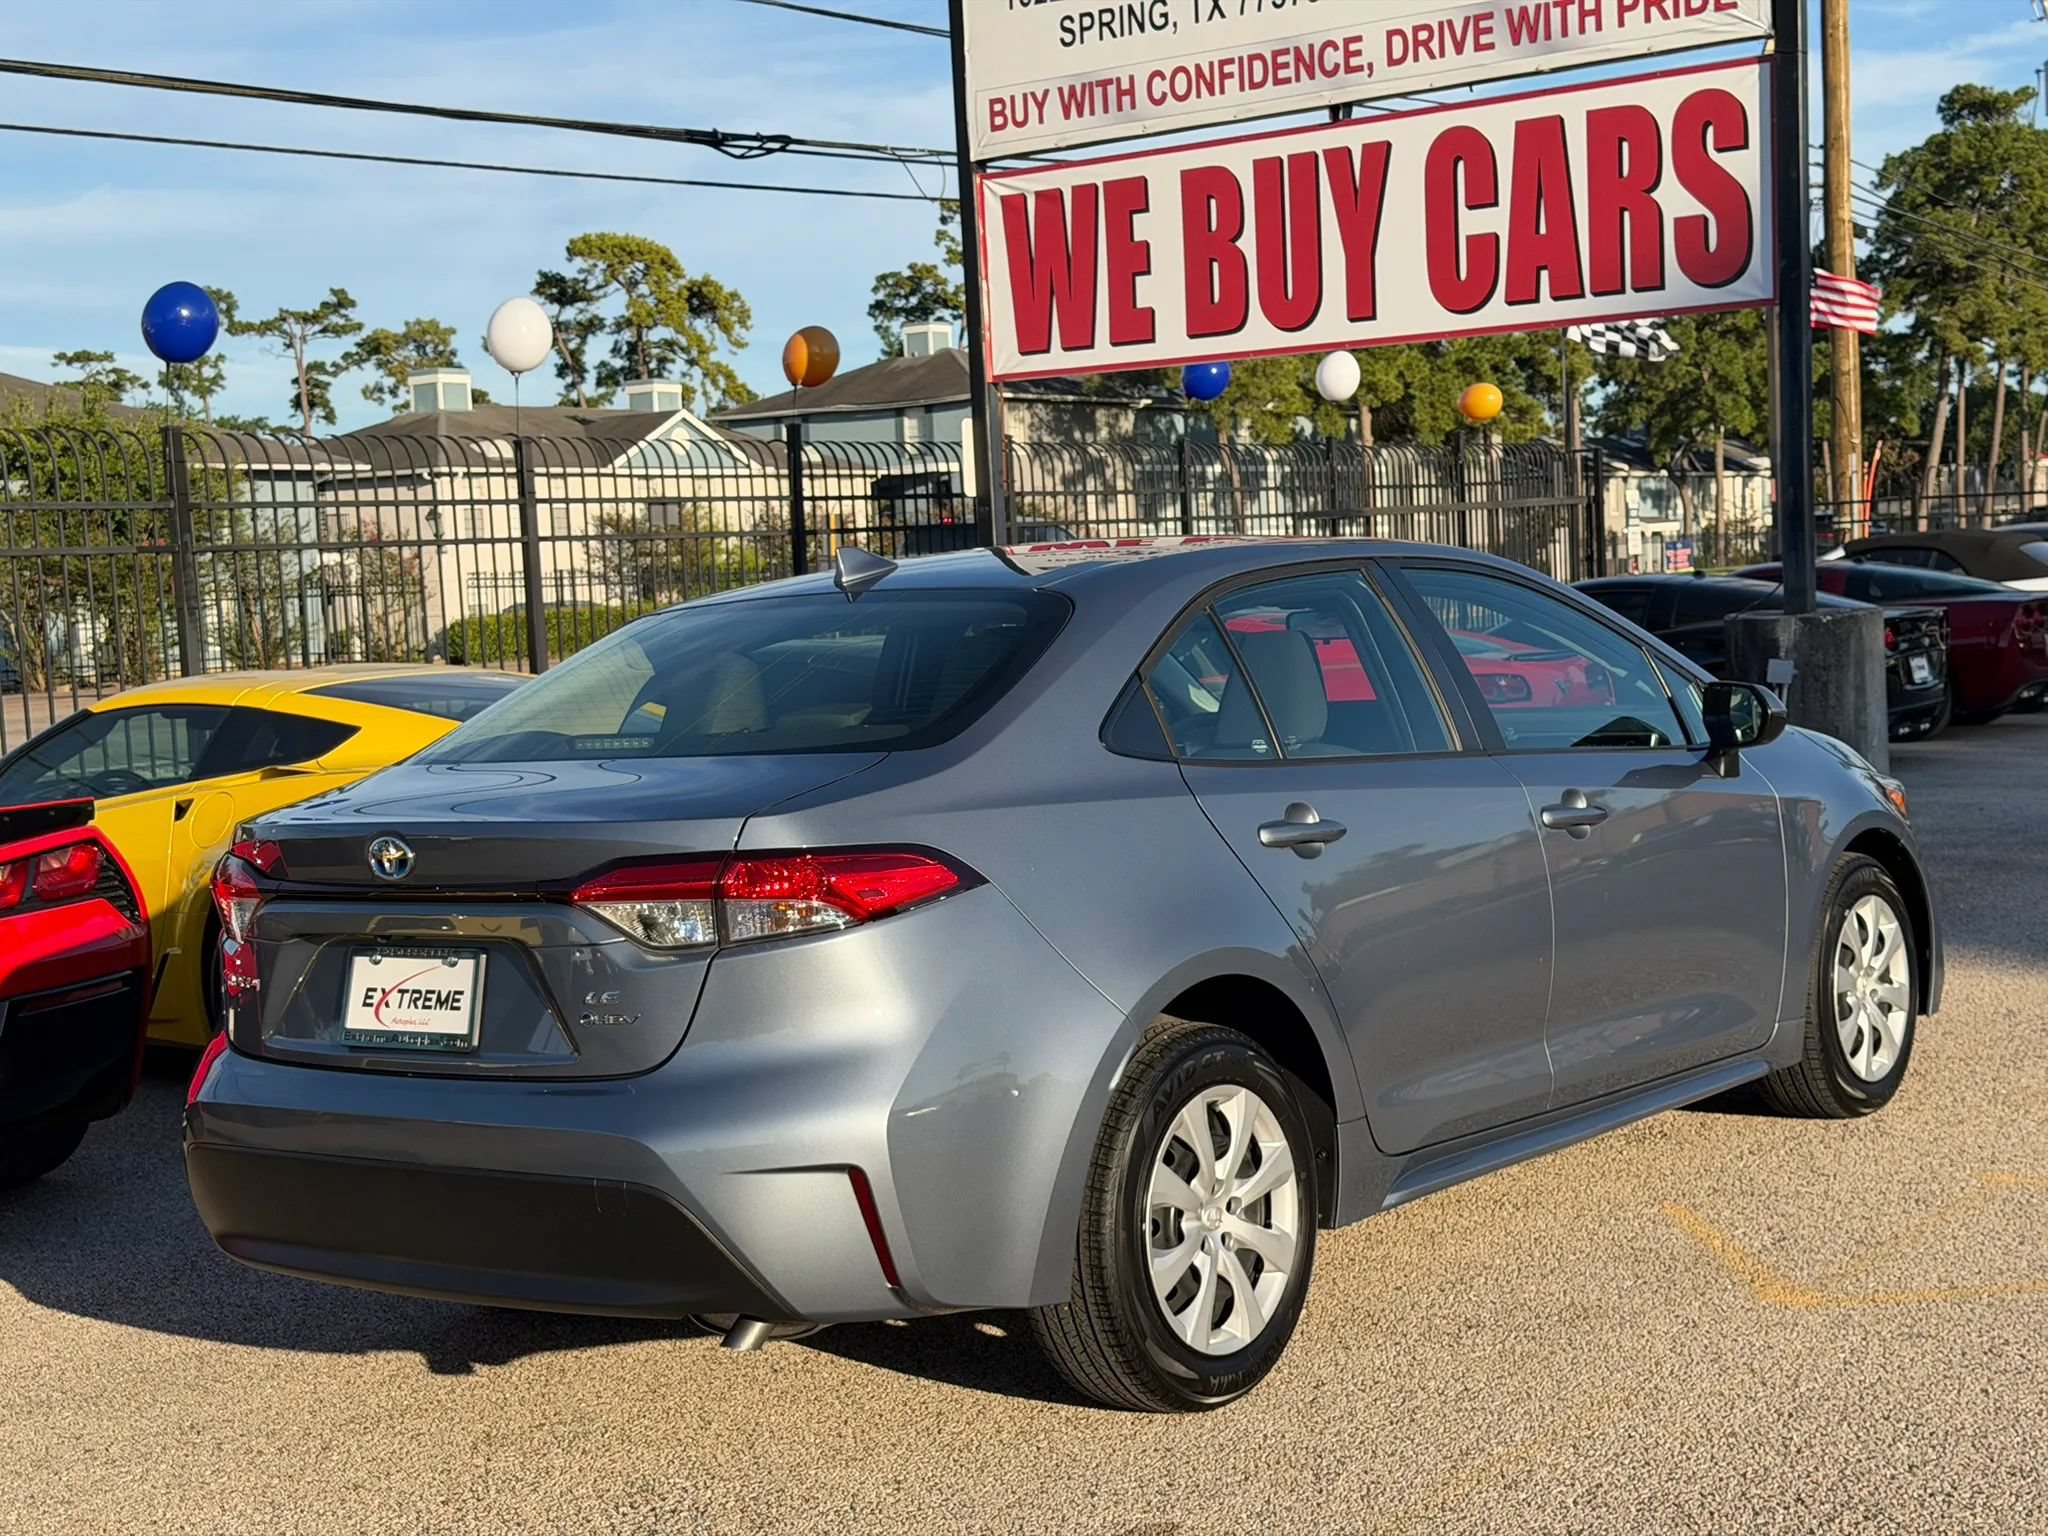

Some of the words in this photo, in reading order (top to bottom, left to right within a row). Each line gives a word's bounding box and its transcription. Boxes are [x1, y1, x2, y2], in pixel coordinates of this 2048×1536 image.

[988, 89, 1050, 133] BUY
[1057, 74, 1136, 120] WITH
[1146, 35, 1374, 107] CONFIDENCE,
[1386, 11, 1496, 68] DRIVE
[1505, 0, 1602, 46] WITH
[1059, 0, 1178, 48] SPRING,
[1000, 175, 1156, 355] WE
[1180, 139, 1392, 338] BUY
[1425, 88, 1753, 315] CARS
[362, 986, 465, 1011] EXTREME
